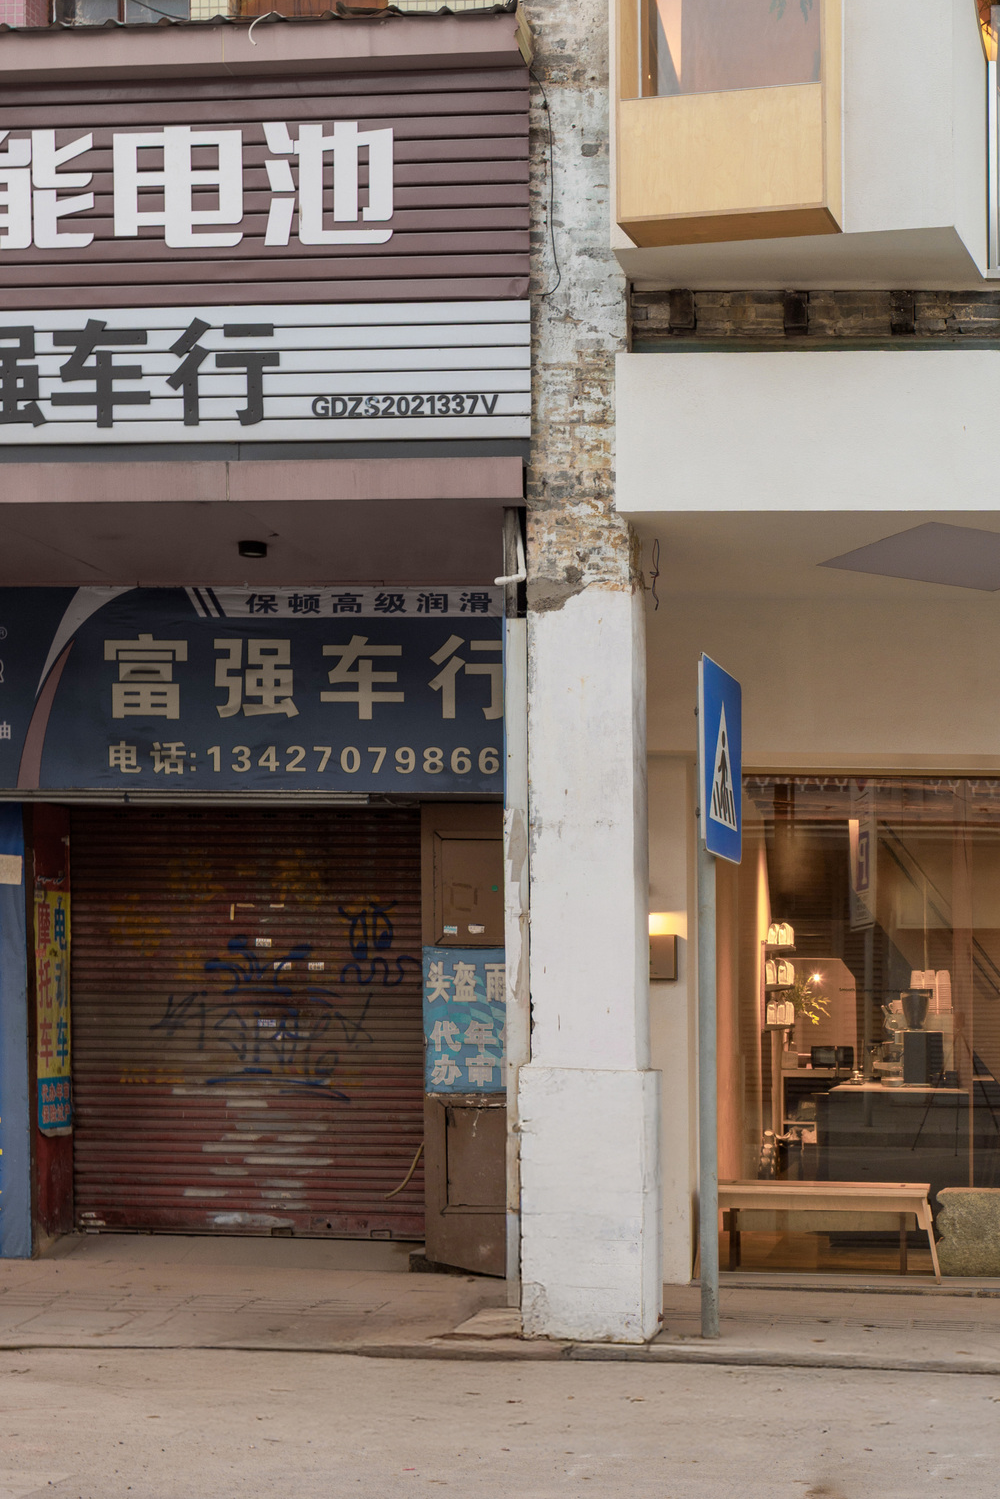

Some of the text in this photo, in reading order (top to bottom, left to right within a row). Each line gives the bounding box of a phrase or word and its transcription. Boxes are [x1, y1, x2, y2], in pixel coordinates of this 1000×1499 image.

[0, 121, 394, 249] 能电池
[311, 394, 499, 417] GDZS2021337V
[245, 593, 493, 614] 保顿高级润滑
[103, 633, 504, 720] 富强车行
[108, 740, 499, 775] 电话:13427079866
